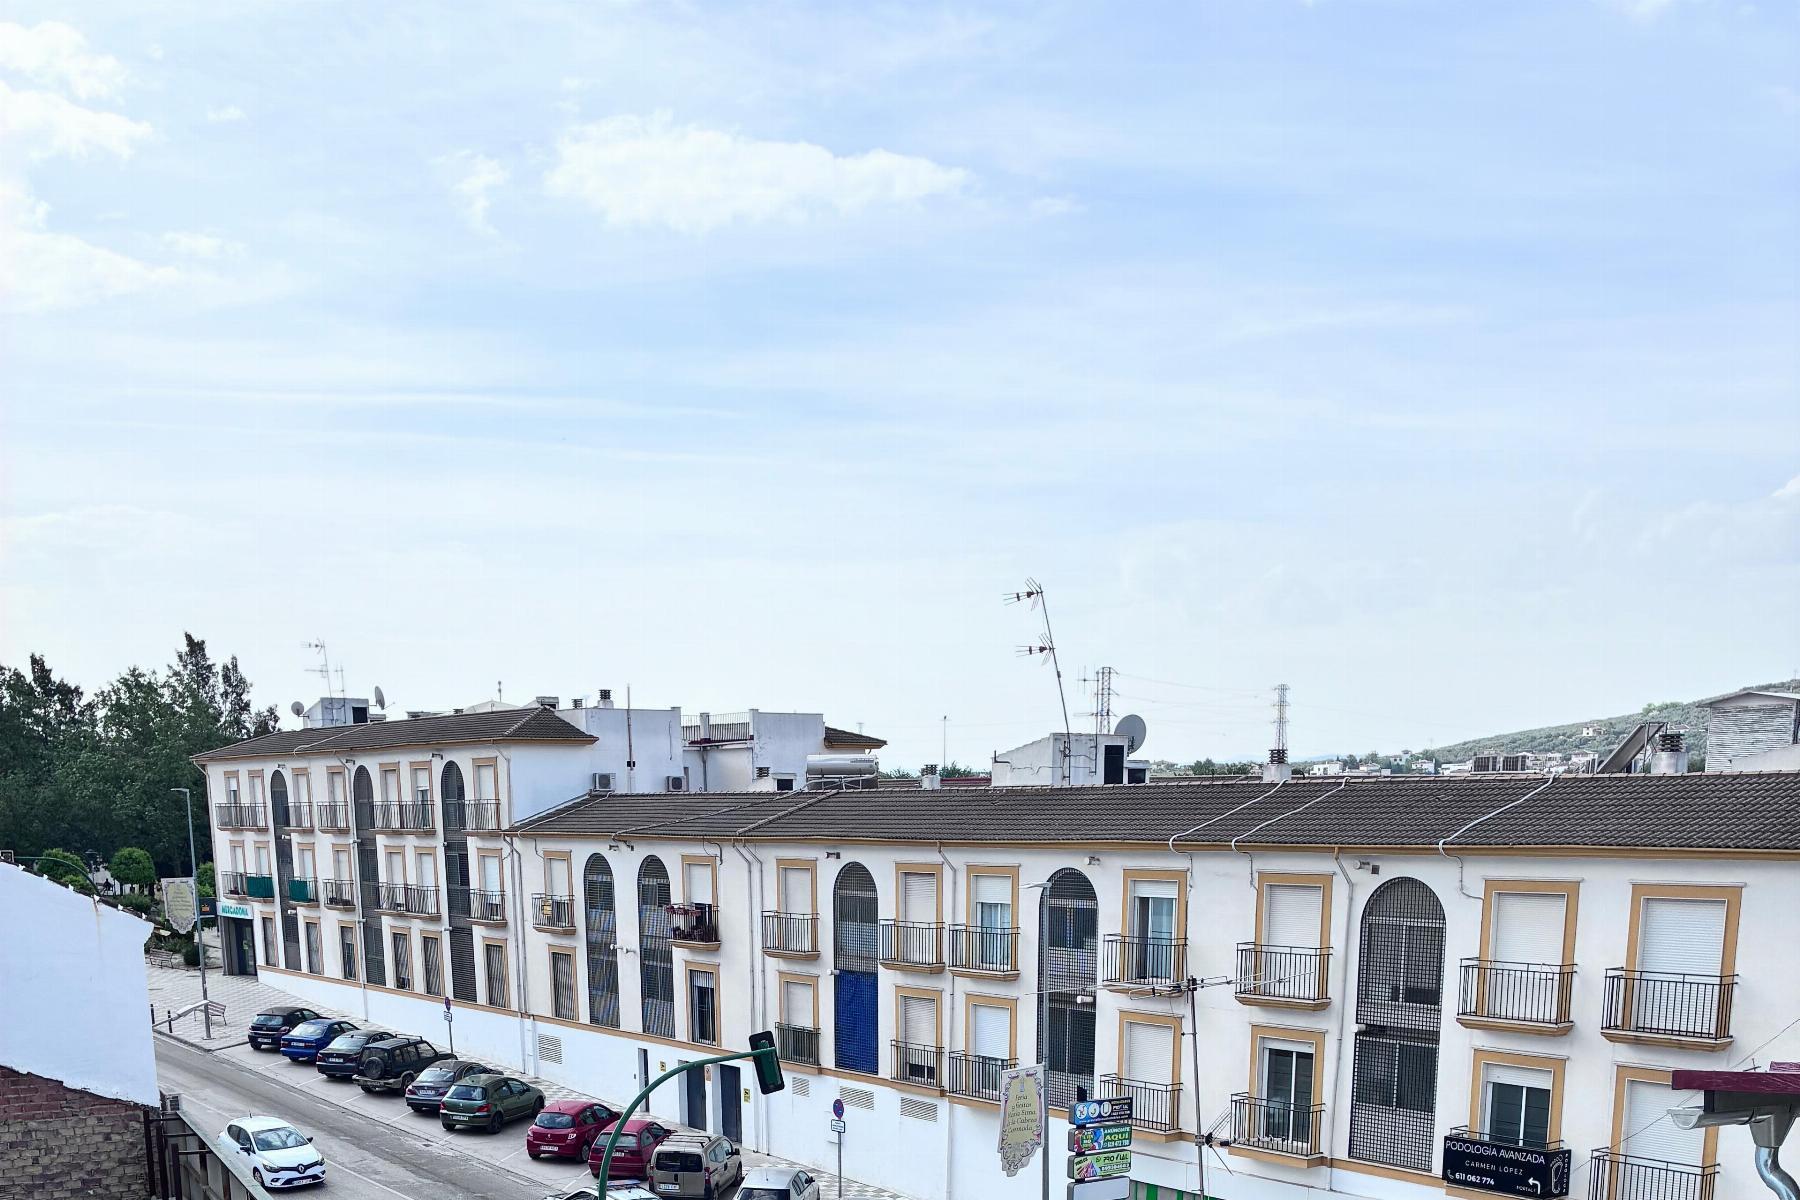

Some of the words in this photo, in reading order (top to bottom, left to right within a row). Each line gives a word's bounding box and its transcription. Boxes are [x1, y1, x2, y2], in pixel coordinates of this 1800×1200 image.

[1445, 1140, 1498, 1157] PODOLOGÍA
[1498, 1149, 1546, 1165] AVANZADA
[1464, 1160, 1496, 1171] CARMEN
[1455, 1172, 1466, 1180] 611
[1466, 1174, 1481, 1183] 062
[1481, 1176, 1495, 1185] 774
